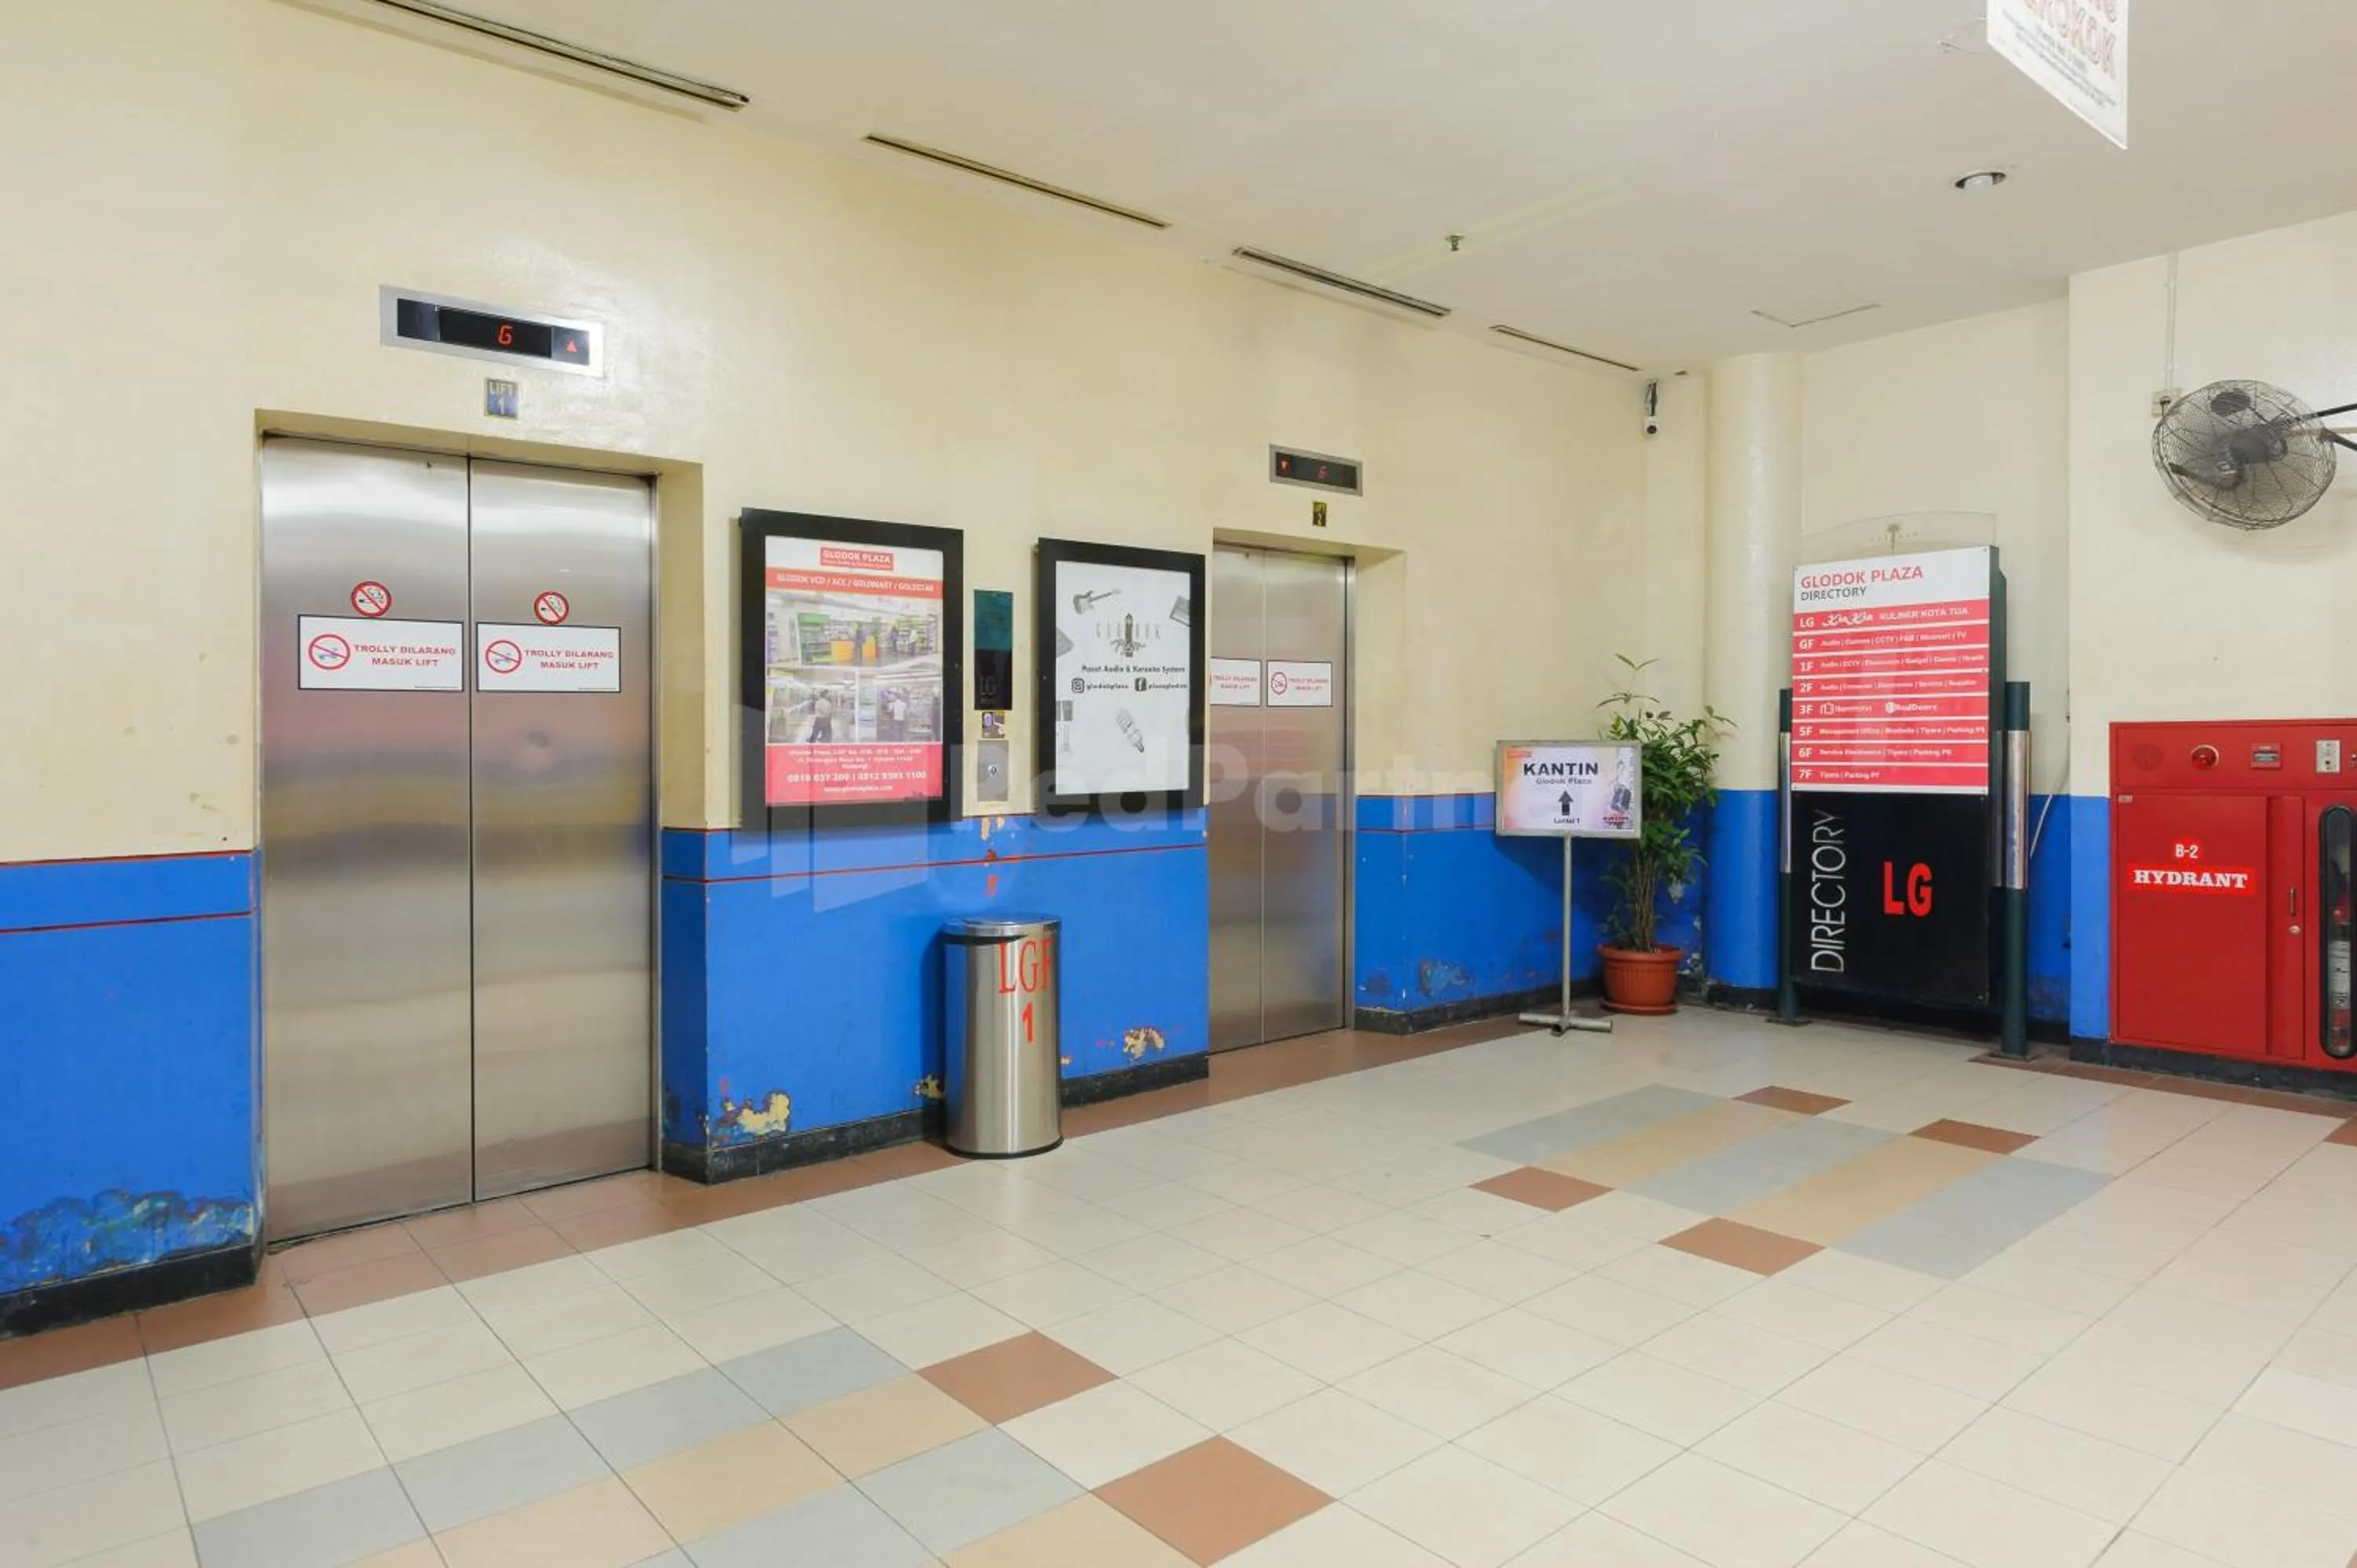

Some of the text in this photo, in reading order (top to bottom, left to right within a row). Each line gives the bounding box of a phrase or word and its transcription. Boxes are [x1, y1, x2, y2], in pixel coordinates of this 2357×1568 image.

[863, 553, 890, 563] PLAZA
[1801, 566, 1923, 588] GLODOK PLAZA
[1801, 587, 1867, 601] DIRECTORY
[1800, 617, 1815, 628] LG
[354, 644, 456, 655] TROLLY DILARANG
[372, 658, 412, 666] MASUK
[541, 661, 575, 669] MASUK
[1801, 661, 1814, 672] 1F
[1800, 683, 1813, 693] 2F
[1799, 704, 1813, 714] 3F
[1799, 727, 1813, 737] 5F
[1798, 749, 1813, 758] 6F
[1523, 763, 1598, 775] KANTIN
[1798, 770, 1812, 779] 7F
[2176, 844, 2198, 859] B-2
[2134, 870, 2248, 888] HYDRANT
[1810, 808, 1846, 972] DIRECTORY
[1883, 860, 1933, 917] LG
[1022, 1002, 1034, 1042] 1
